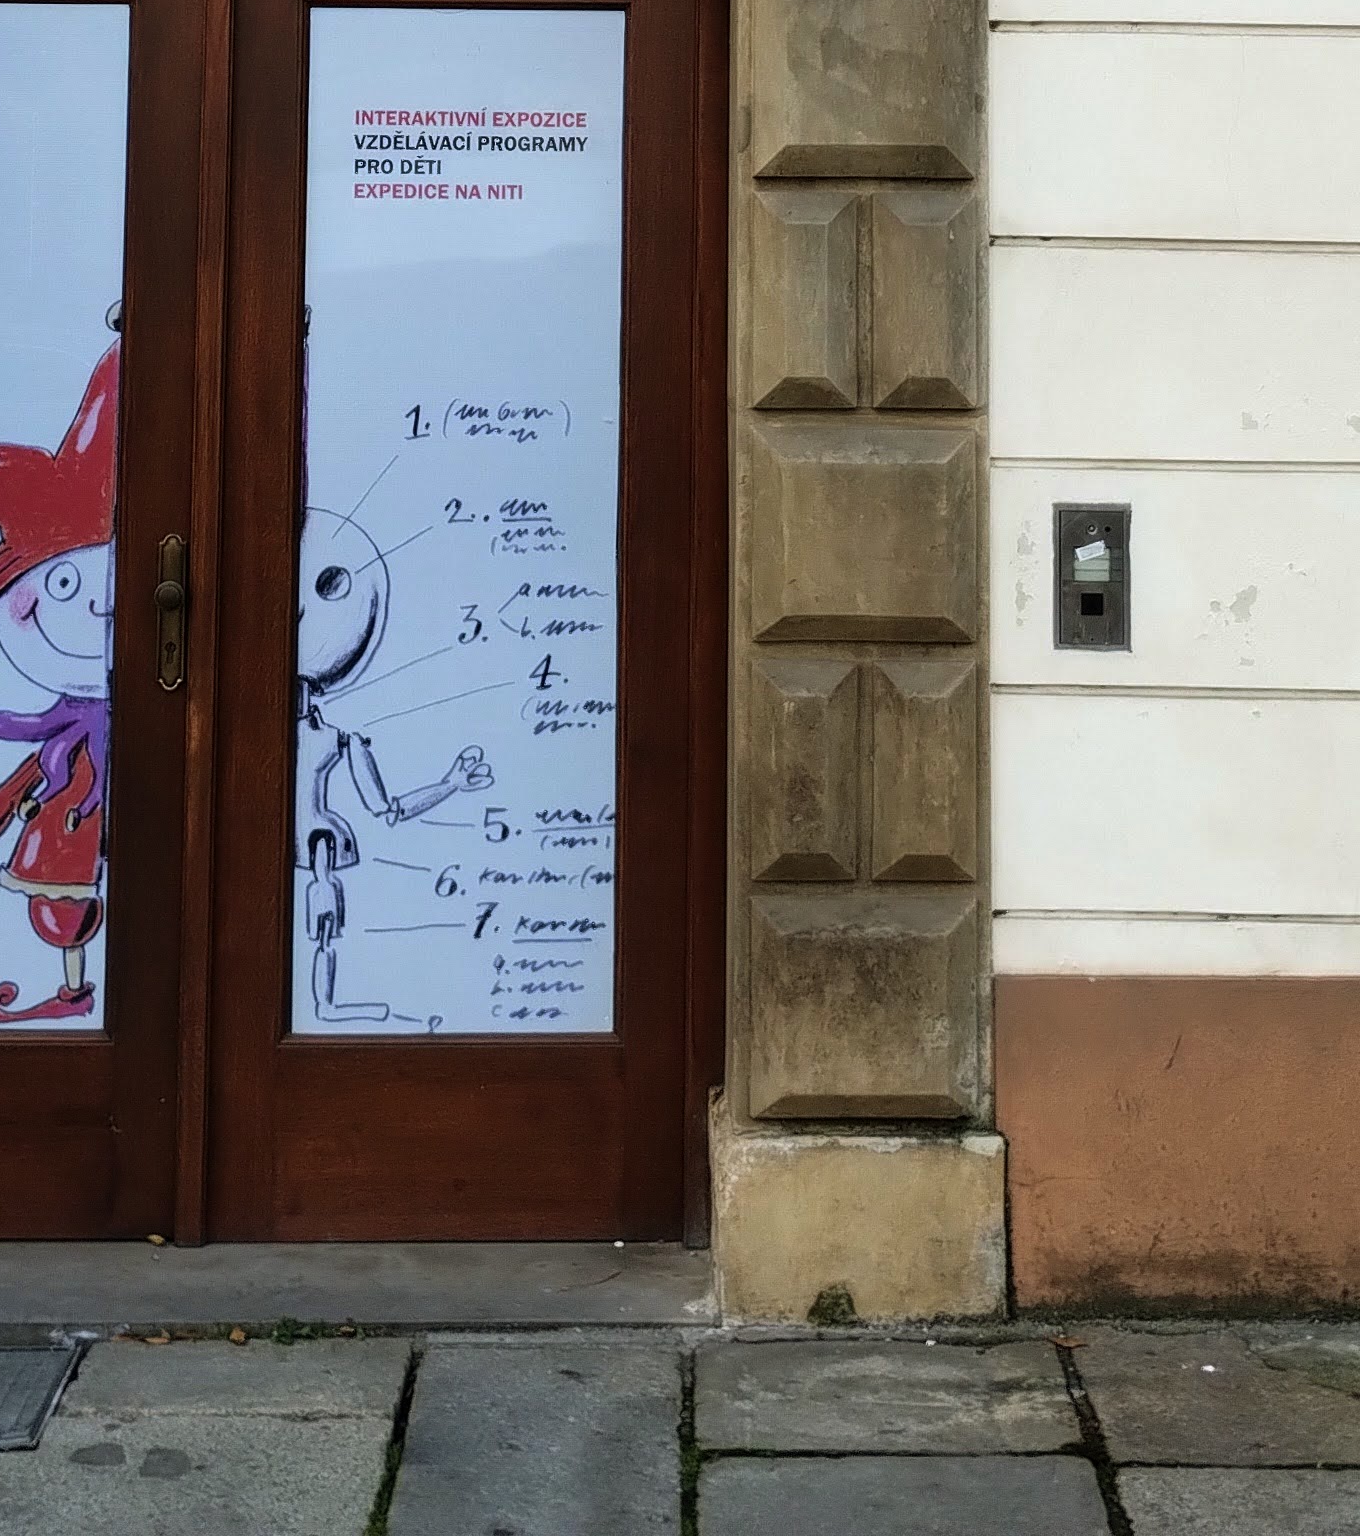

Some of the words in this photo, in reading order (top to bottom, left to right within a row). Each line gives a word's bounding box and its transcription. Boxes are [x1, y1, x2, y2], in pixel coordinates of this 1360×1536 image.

[354, 107, 487, 127] INTERAKTIVNÍ
[492, 112, 587, 128] EXPOZICE
[354, 131, 472, 150] VZDĚLÁVACÍ
[477, 136, 588, 151] PROGRAMY
[354, 158, 393, 174] PRO
[400, 155, 441, 174] DĚTI
[353, 183, 449, 199] EXPEDICE
[455, 185, 481, 199] NA
[488, 185, 523, 200] NITI
[404, 405, 431, 440] 1.
[458, 604, 489, 644] 3.
[529, 654, 569, 690] 4.
[484, 807, 522, 843] 5.
[435, 864, 466, 897] 6.
[473, 902, 500, 939] 7.
